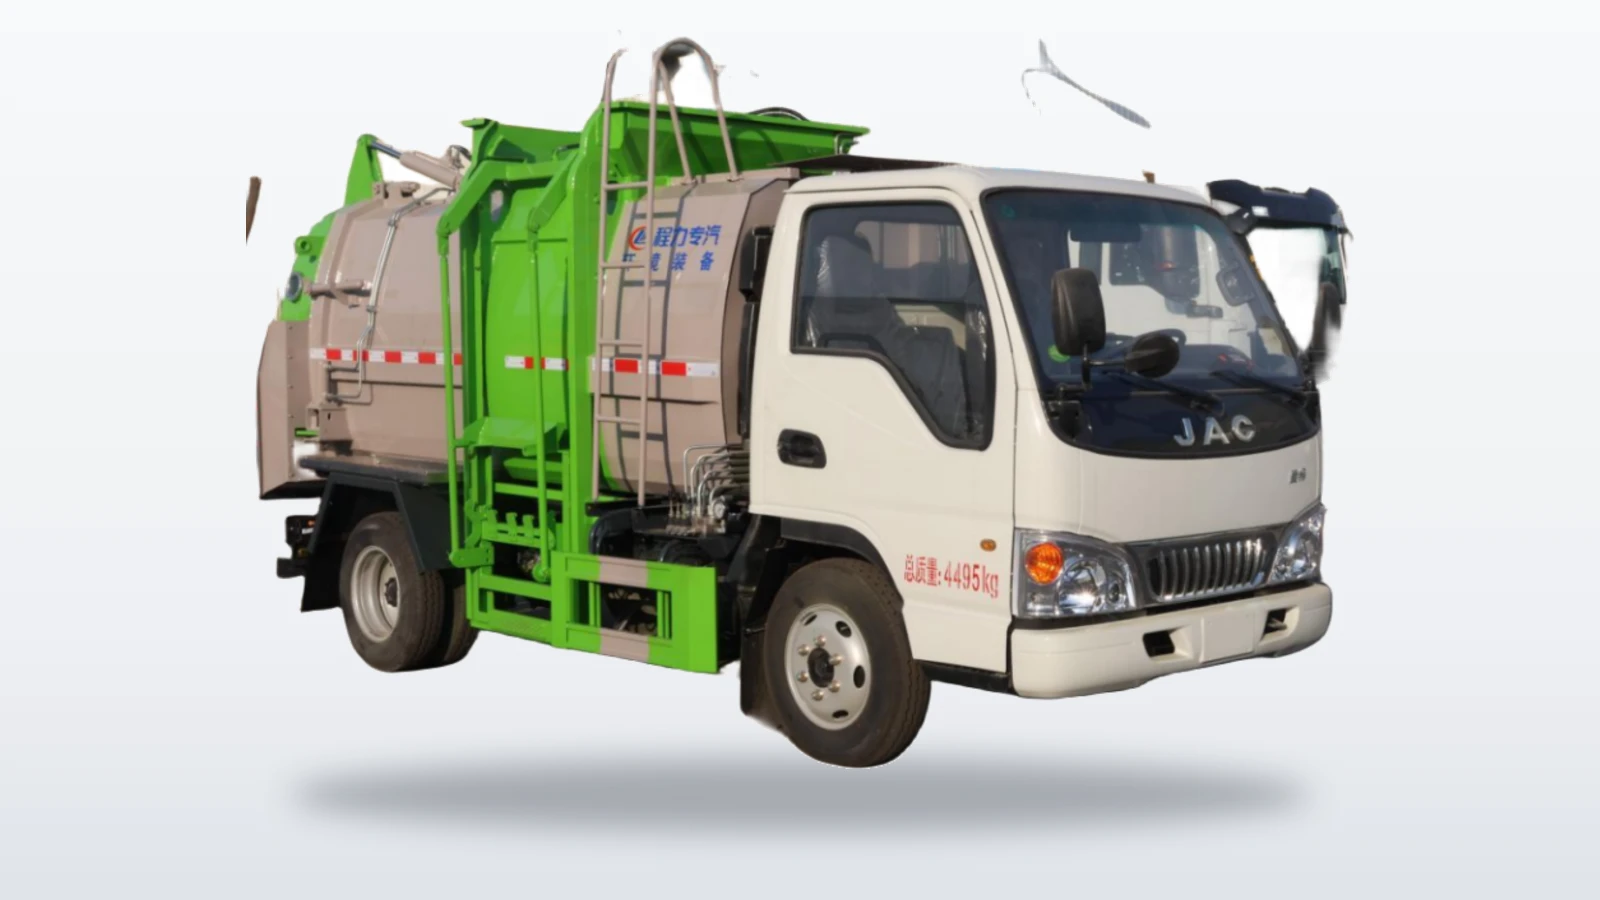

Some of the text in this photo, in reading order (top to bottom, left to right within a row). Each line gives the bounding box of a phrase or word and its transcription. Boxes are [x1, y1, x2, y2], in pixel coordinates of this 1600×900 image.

[653, 225, 721, 247] 程力专汽
[1173, 414, 1256, 447] JAC
